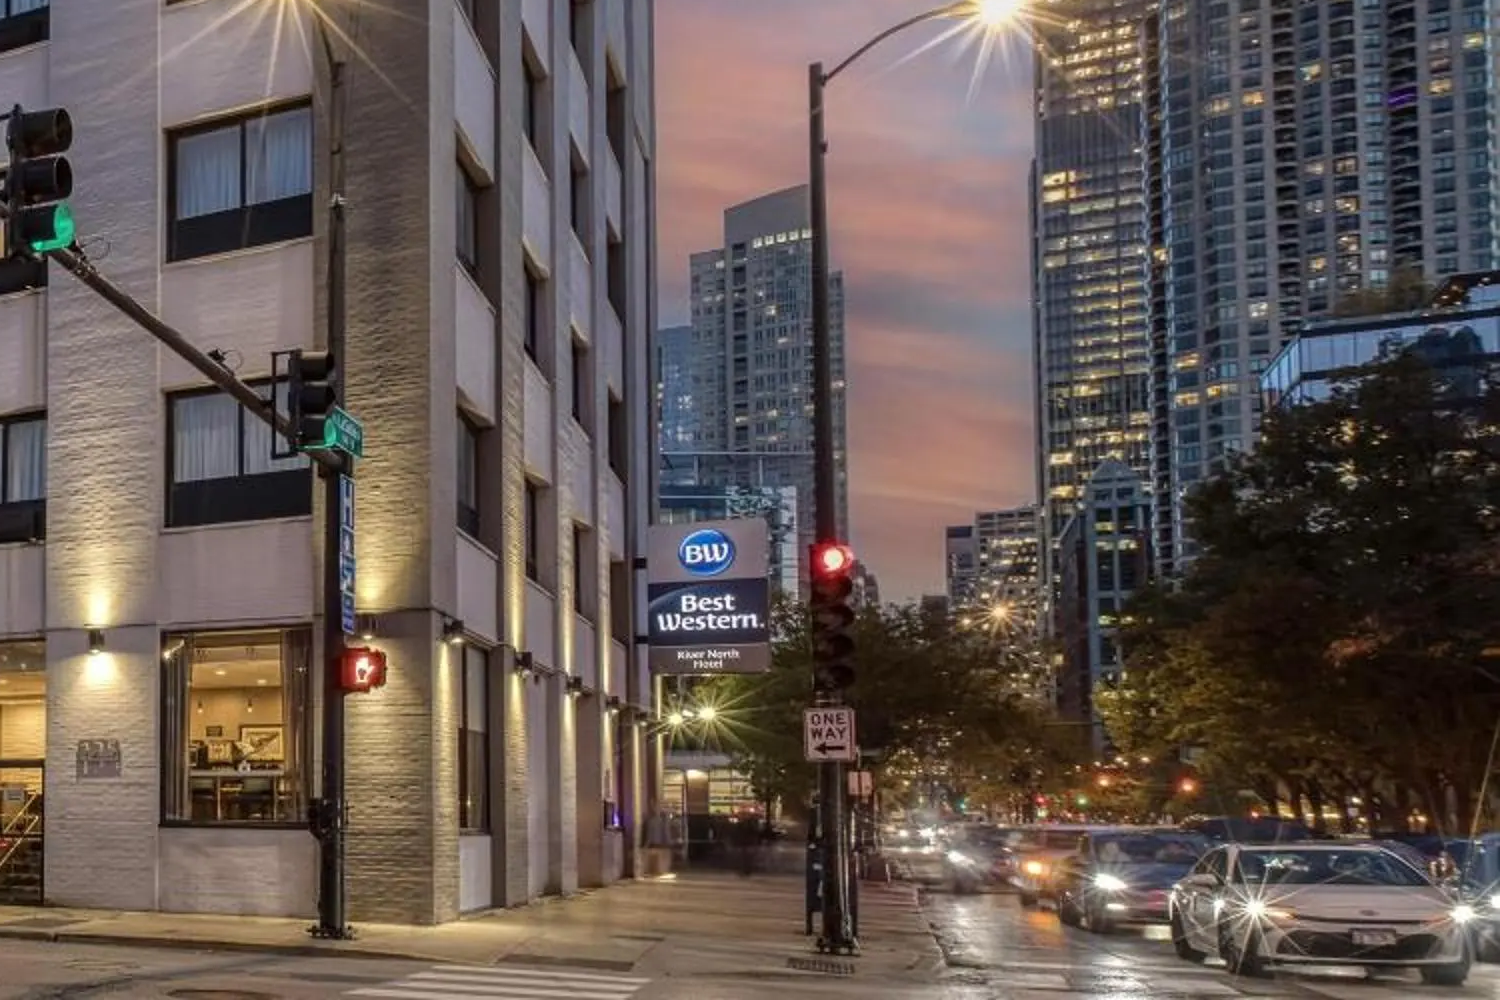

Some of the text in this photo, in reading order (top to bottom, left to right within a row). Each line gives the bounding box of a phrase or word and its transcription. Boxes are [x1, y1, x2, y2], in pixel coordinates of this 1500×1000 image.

[684, 543, 729, 563] BW
[681, 594, 736, 613] Best
[677, 649, 740, 660] River North
[693, 659, 723, 669] Hotel
[811, 712, 847, 726] ONE
[811, 727, 846, 739] WAY
